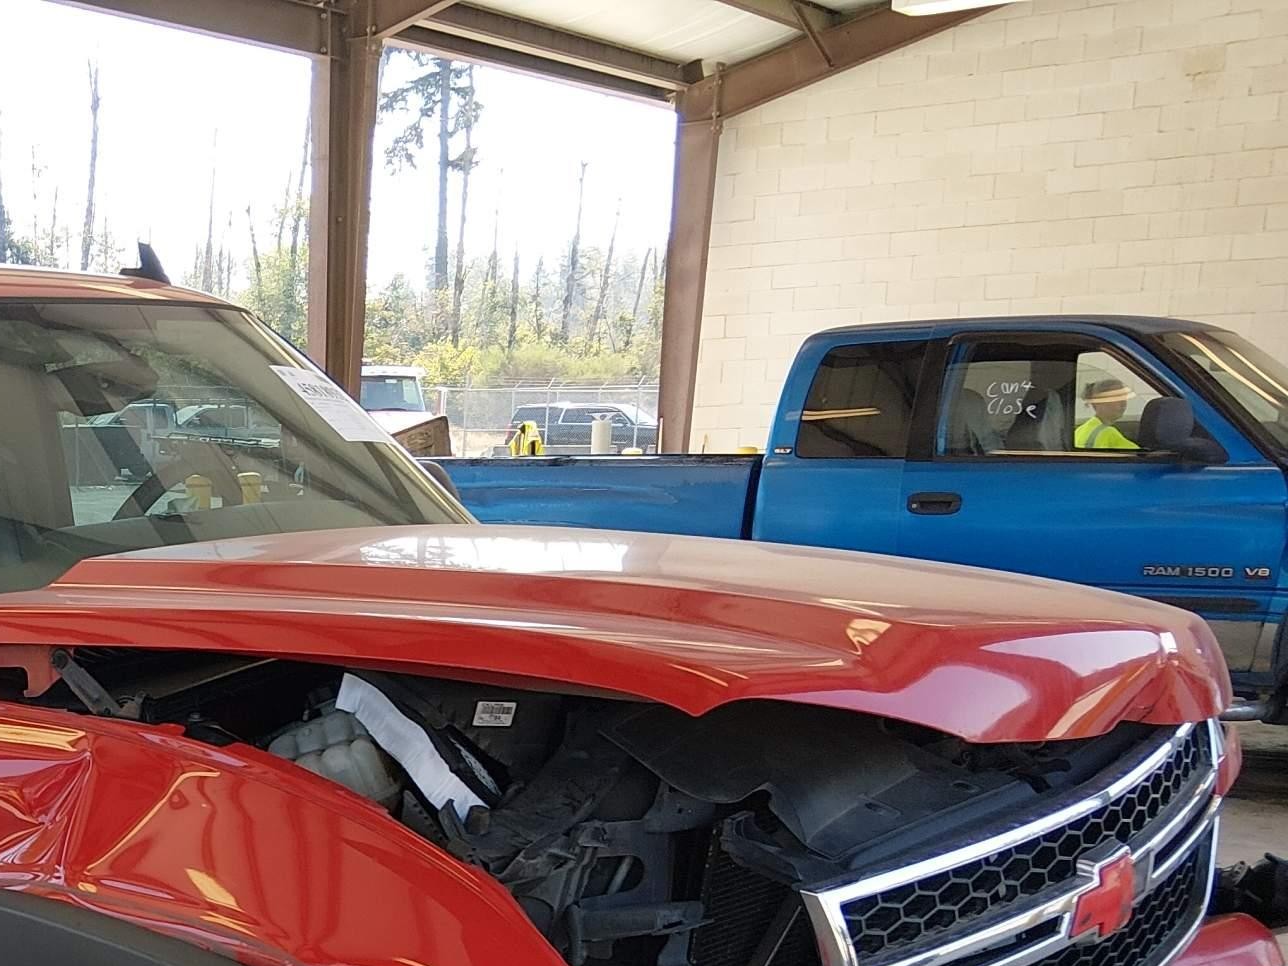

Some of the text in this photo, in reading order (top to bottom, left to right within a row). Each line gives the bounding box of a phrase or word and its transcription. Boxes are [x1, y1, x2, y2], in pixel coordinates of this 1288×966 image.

[1143, 566, 1271, 578] RAM 1500 V8
